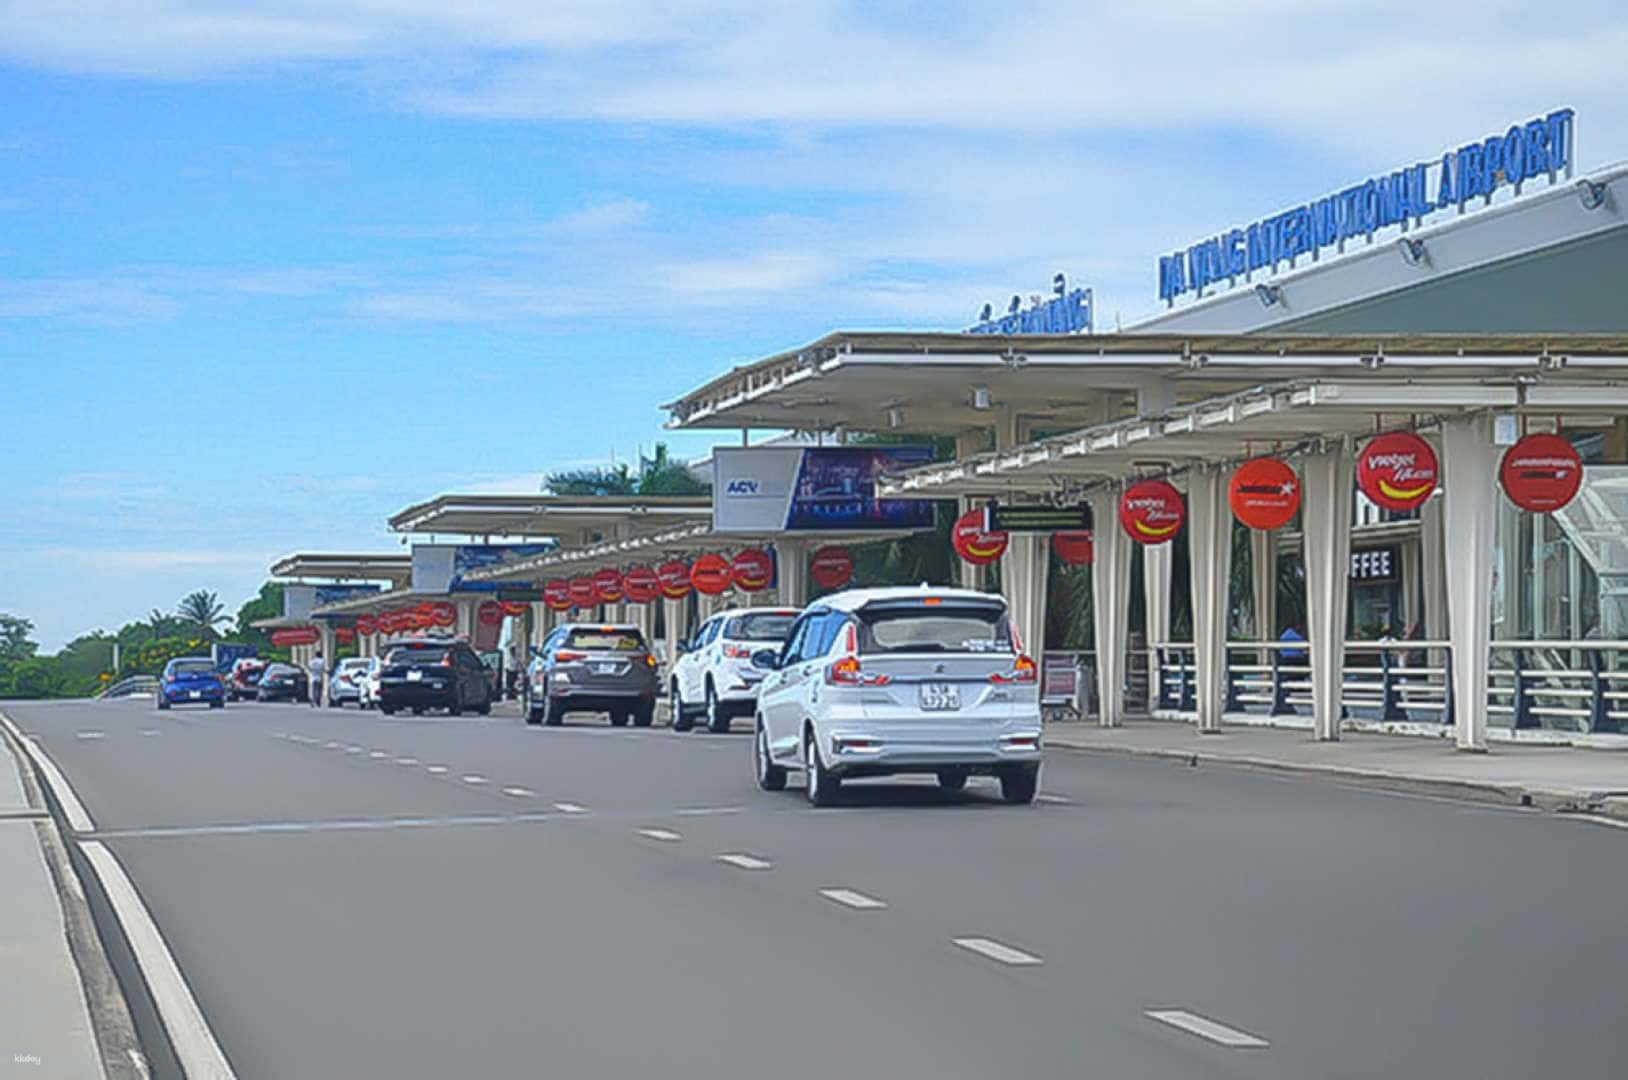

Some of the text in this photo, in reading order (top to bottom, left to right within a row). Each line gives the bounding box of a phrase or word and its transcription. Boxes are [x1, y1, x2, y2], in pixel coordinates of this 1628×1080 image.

[1438, 109, 1575, 208] AIRPORT
[727, 481, 759, 493] ACV
[1351, 551, 1391, 578] FFEE
